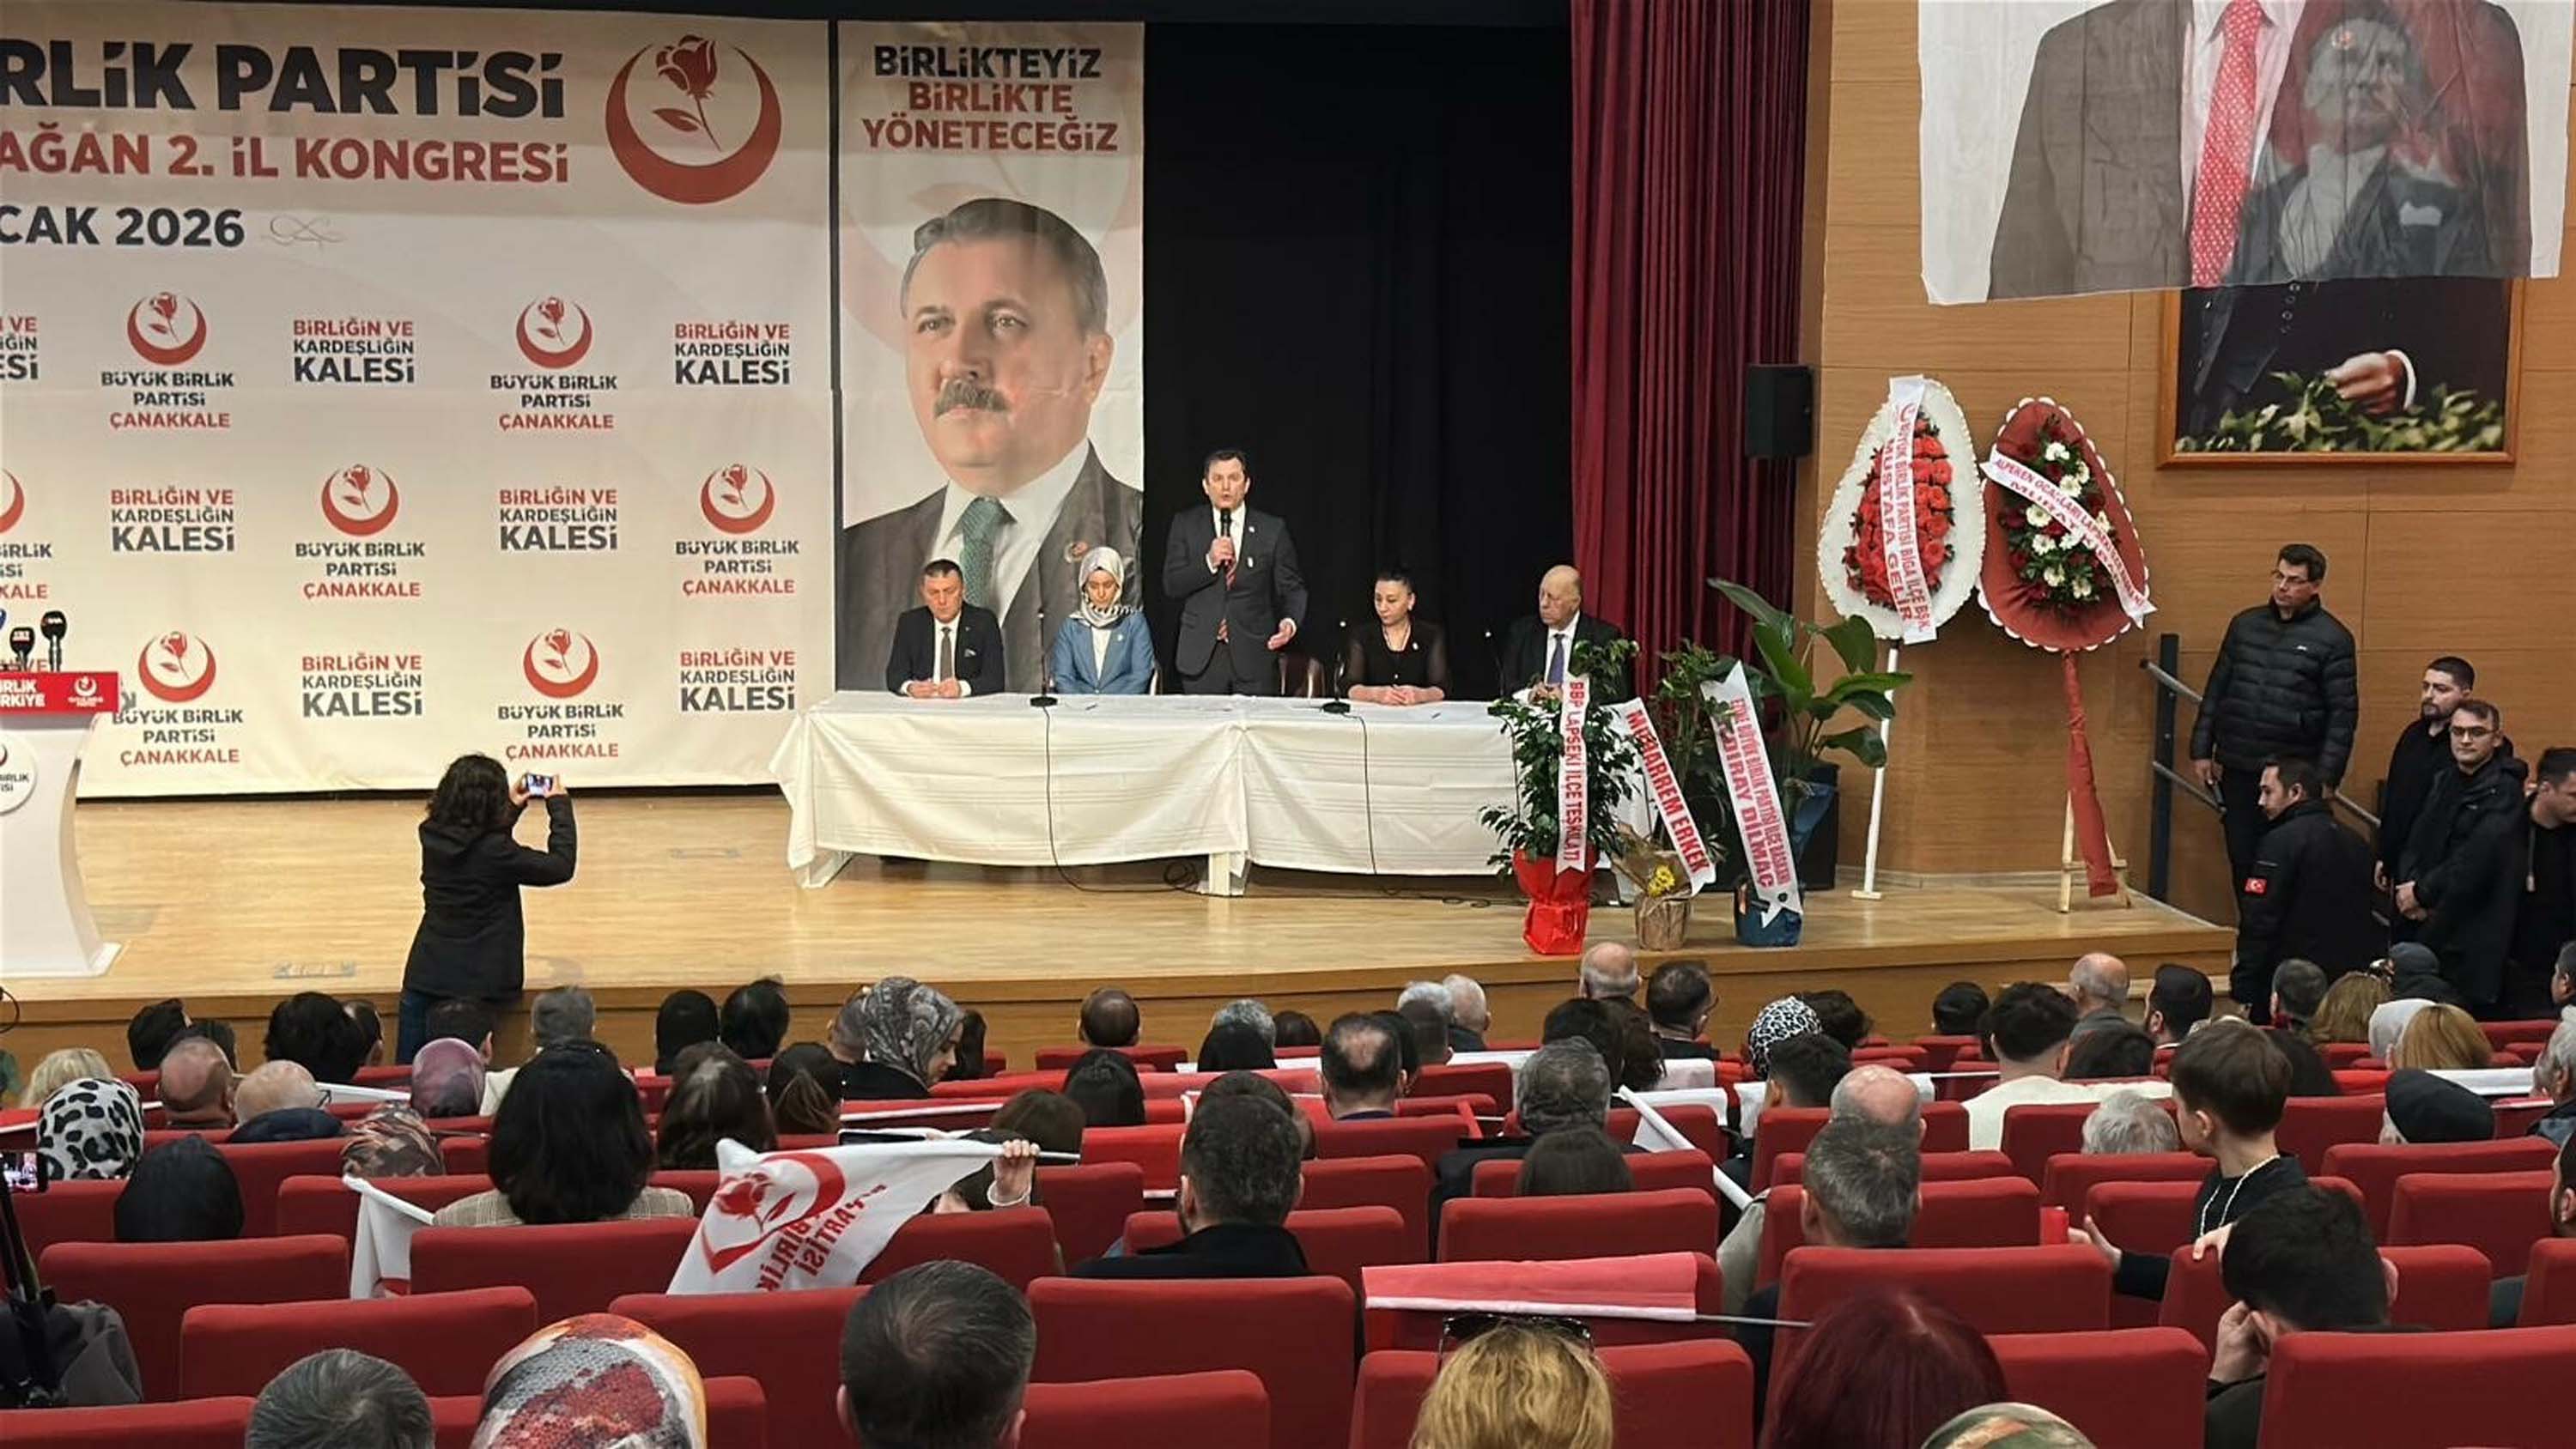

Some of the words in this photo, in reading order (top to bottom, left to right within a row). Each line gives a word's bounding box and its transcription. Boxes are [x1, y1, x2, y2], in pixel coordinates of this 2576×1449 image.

[874, 45, 1102, 79] BİRLİKTEYİZ
[216, 45, 564, 118] PARTİSİ
[908, 81, 1073, 113] BİRLİKTE
[862, 112, 1118, 152] YÖNETECEĞİZ
[168, 135, 214, 176] 2.
[233, 136, 278, 179] İL
[296, 138, 568, 183] KONGRESİ
[115, 208, 245, 247] 2026
[10, 317, 37, 332] VE
[294, 318, 380, 336] BİRLİĞİN
[387, 321, 413, 336] VE
[675, 320, 759, 339] BİRLİĞİN
[765, 324, 789, 339] VE
[294, 338, 413, 355] KARDEŞLİĞİN
[675, 341, 789, 358] KARDEŞLİĞİN
[295, 357, 414, 382] KALESİ
[676, 360, 789, 385] KALESİ
[101, 372, 167, 386] BÜYÜK
[173, 373, 234, 386] BİRLİK
[490, 374, 554, 389] BÜYÜK
[559, 375, 617, 390] BİRLİK
[134, 391, 205, 406] PARTİSİ
[521, 393, 591, 408] PARTİSİ
[110, 412, 230, 429] ÇANAKKALE
[499, 414, 614, 430] ÇANAKKALE
[111, 486, 200, 505] BİRLİĞİN
[207, 489, 234, 505] VE
[500, 486, 585, 505] BİRLİĞİN
[592, 489, 617, 505] VE
[1880, 439, 1899, 544] MUSTAFA
[112, 506, 234, 524] KARDEŞLİĞİN
[500, 506, 617, 524] KARDEŞLİĞİN
[112, 526, 235, 552] KALESİ
[501, 525, 617, 550] KALESİ
[295, 542, 361, 557] BÜYÜK
[365, 543, 425, 556] BİRLİK
[676, 540, 738, 555] BÜYÜK
[742, 540, 799, 555] BİRLİK
[326, 562, 397, 576] PARTİSİ
[705, 559, 772, 573] PARTİSİ
[303, 583, 421, 599] ÇANAKKALE
[683, 579, 795, 596] ÇANAKKALE
[1887, 552, 1911, 621] GELİR
[302, 652, 389, 671] BİRLİĞİN
[396, 655, 422, 670] VE
[680, 648, 763, 666] BİRLİĞİN
[770, 651, 795, 666] VE
[302, 672, 422, 689] KARDEŞLİĞİN
[680, 667, 795, 684] KARDEŞLİĞİN
[681, 686, 795, 712] KALESİ
[1569, 682, 1584, 706] BBP
[303, 690, 422, 718] KALESİ
[498, 706, 561, 719] BÜYÜK
[565, 704, 624, 718] BİRLİK
[183, 709, 243, 724] BİRLİK
[143, 729, 215, 744] PARTİSİ
[527, 724, 596, 738] PARTİSİ
[120, 749, 240, 767] ÇANAKKALE
[506, 743, 619, 762] ÇANAKKALE
[1670, 816, 1710, 874] ERKEK
[1739, 807, 1776, 888] DİLMAÇ
